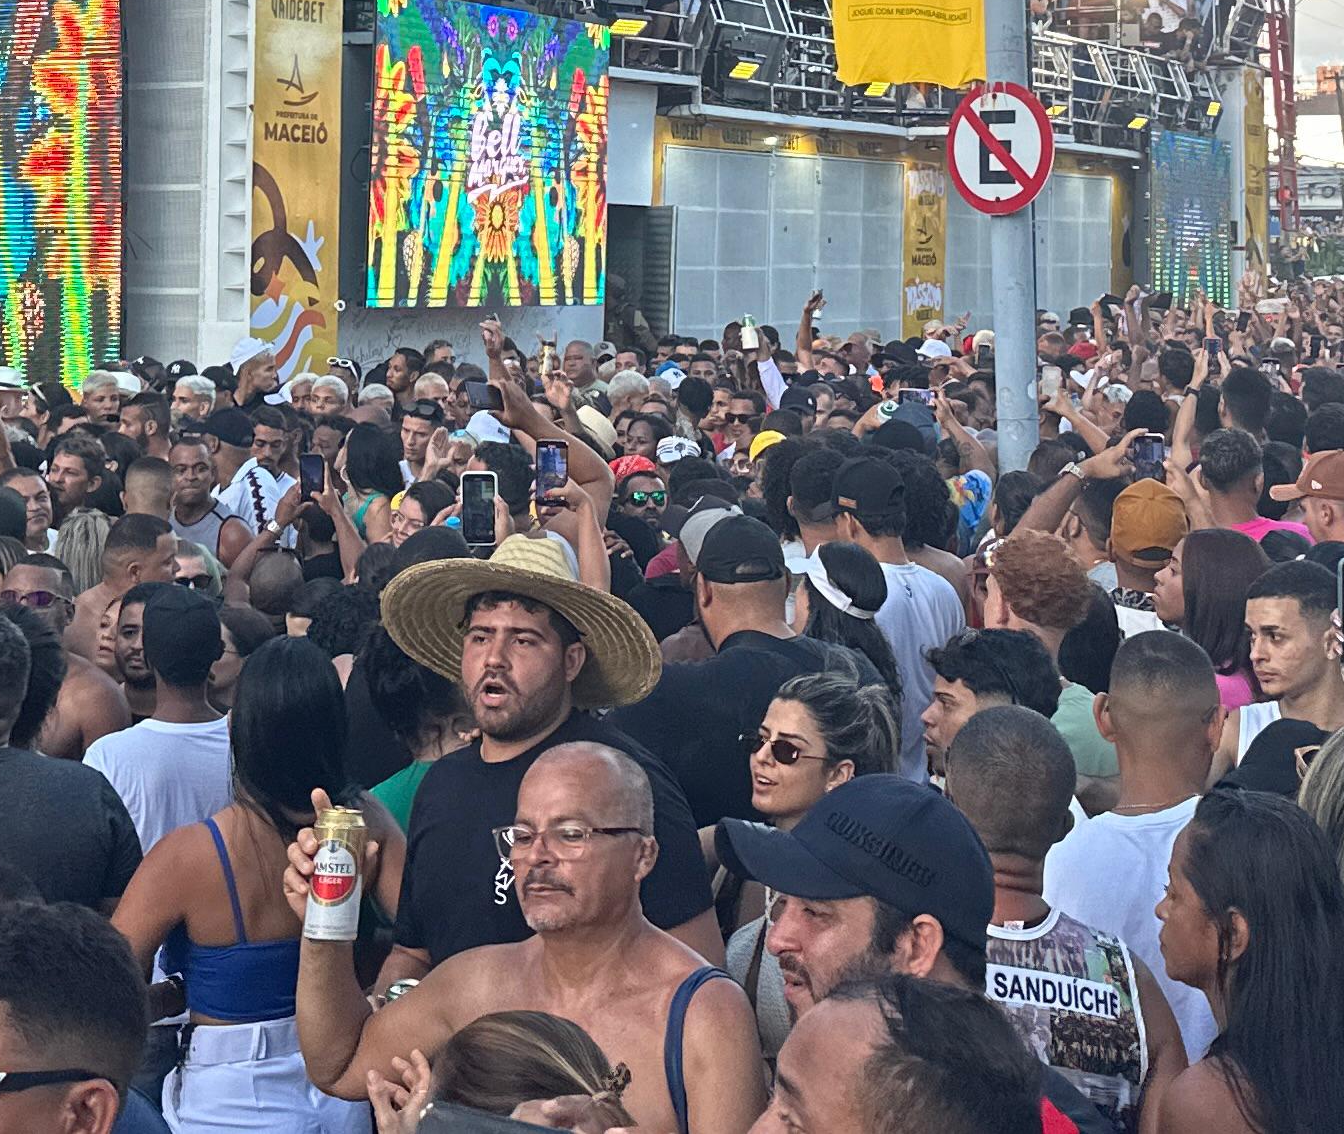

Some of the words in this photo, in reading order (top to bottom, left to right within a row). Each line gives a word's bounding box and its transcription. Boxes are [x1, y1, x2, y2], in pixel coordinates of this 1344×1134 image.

[876, 7, 894, 16] COM
[264, 121, 328, 145] MACEIÓ
[979, 109, 1017, 185] E
[315, 862, 352, 875] AMSTEL
[318, 875, 343, 885] LAGER
[993, 971, 1119, 1017] SANDUÍCHE
